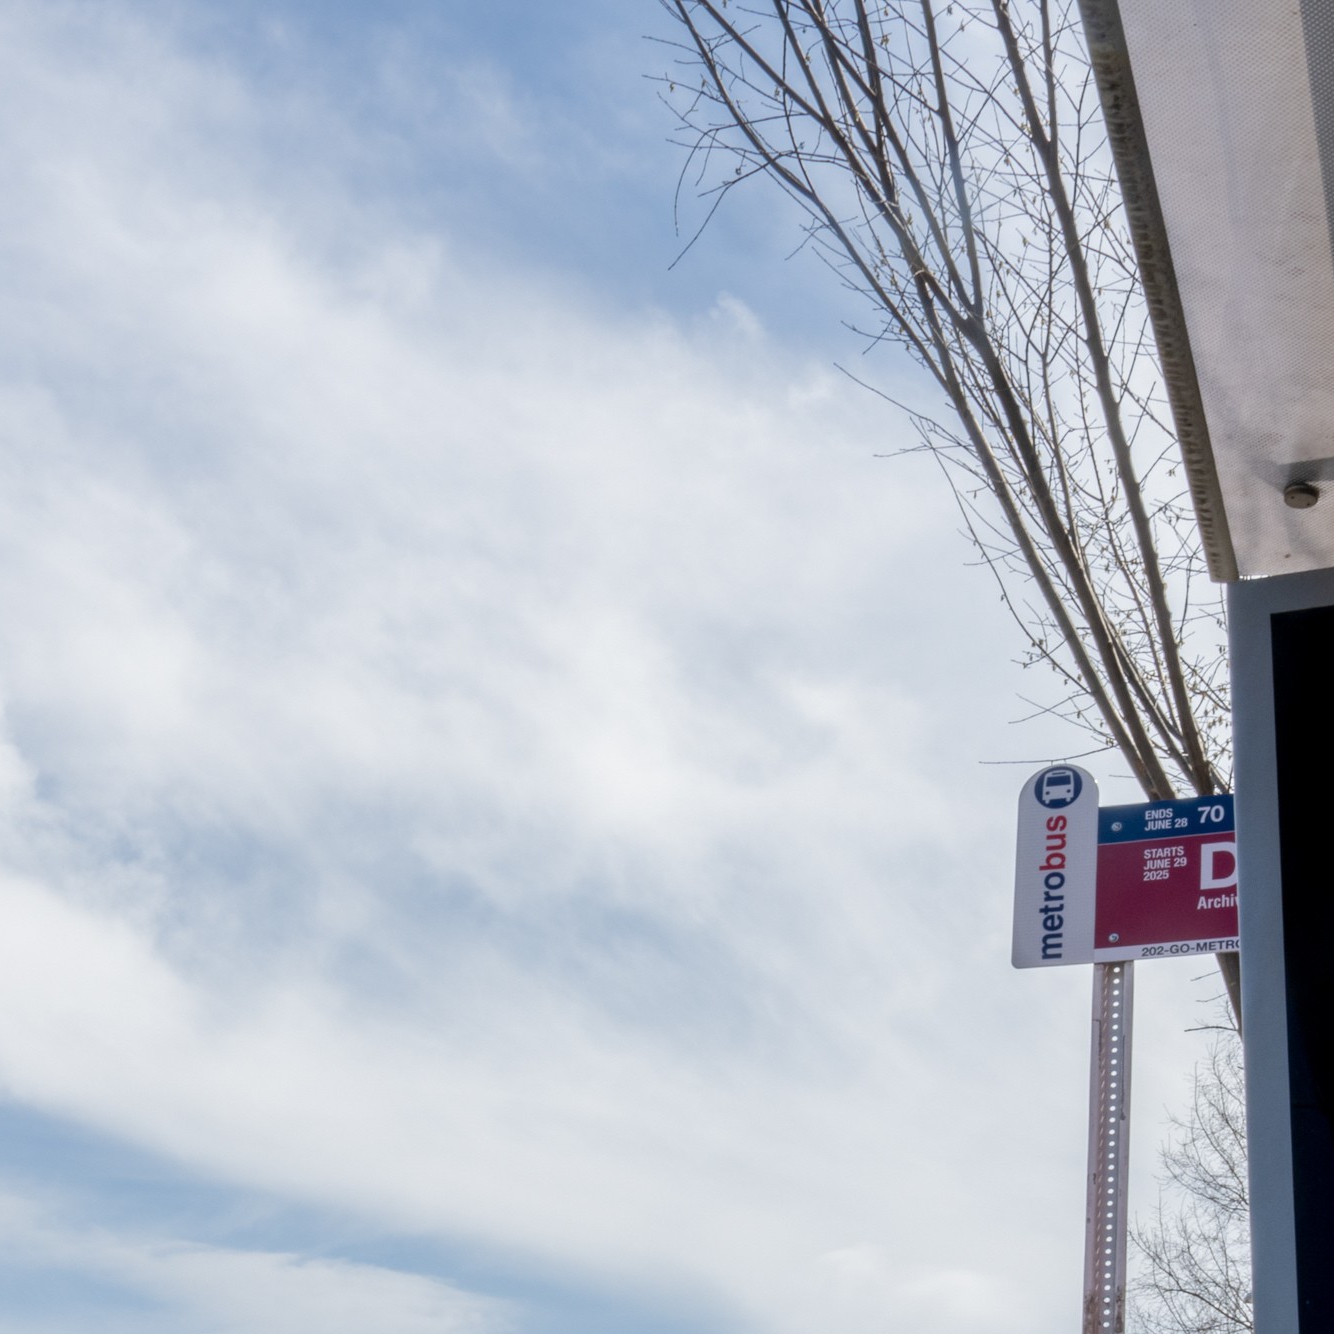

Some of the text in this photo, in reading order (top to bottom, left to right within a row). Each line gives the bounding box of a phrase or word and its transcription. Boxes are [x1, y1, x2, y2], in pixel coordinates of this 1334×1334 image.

[1144, 808, 1173, 820] ENDS
[1197, 805, 1225, 824] 70
[1144, 817, 1188, 831] JUNE 28
[1143, 846, 1185, 859] STARTS
[1143, 856, 1188, 870] JUNE 29
[1143, 869, 1170, 882] 2025
[1039, 815, 1068, 960] metrobus
